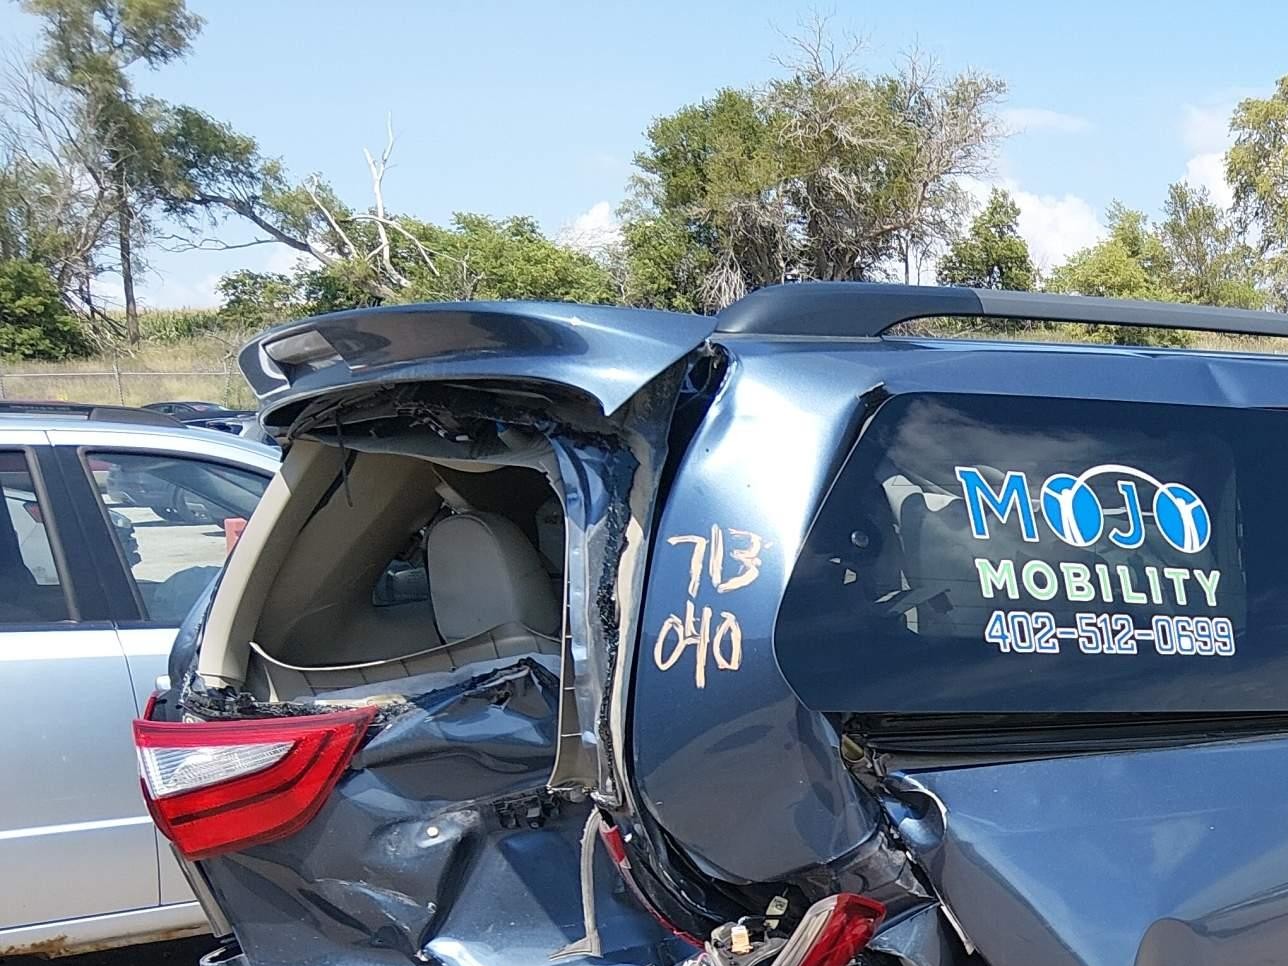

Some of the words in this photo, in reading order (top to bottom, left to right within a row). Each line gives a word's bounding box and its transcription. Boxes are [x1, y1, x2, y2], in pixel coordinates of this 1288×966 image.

[954, 465, 1211, 553] MOJO
[667, 523, 764, 599] 713
[975, 558, 1221, 606] MOBILITY
[653, 599, 743, 688] 040
[984, 610, 1236, 656] 402-512-0699
